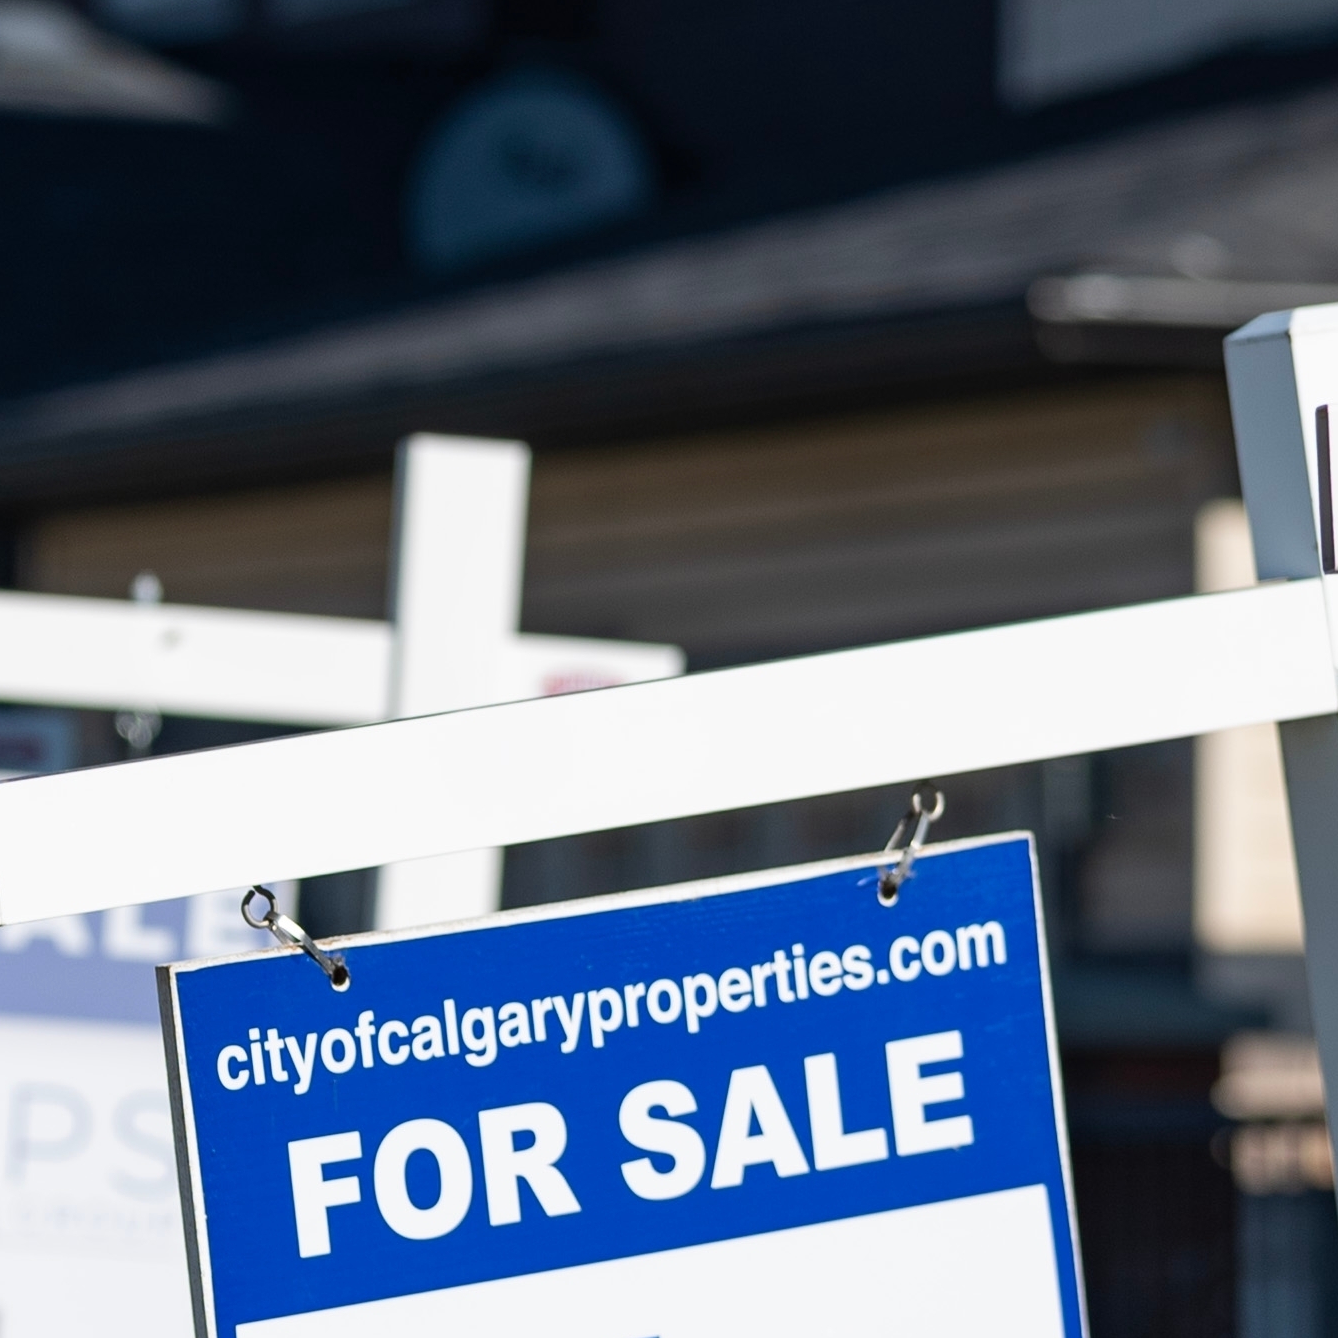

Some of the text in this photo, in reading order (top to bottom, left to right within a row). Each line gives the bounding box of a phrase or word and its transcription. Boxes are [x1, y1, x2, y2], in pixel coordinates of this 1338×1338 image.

[217, 921, 1006, 1094] cityofcalgaryproperties.com
[288, 1031, 973, 1258] FOR SALE
